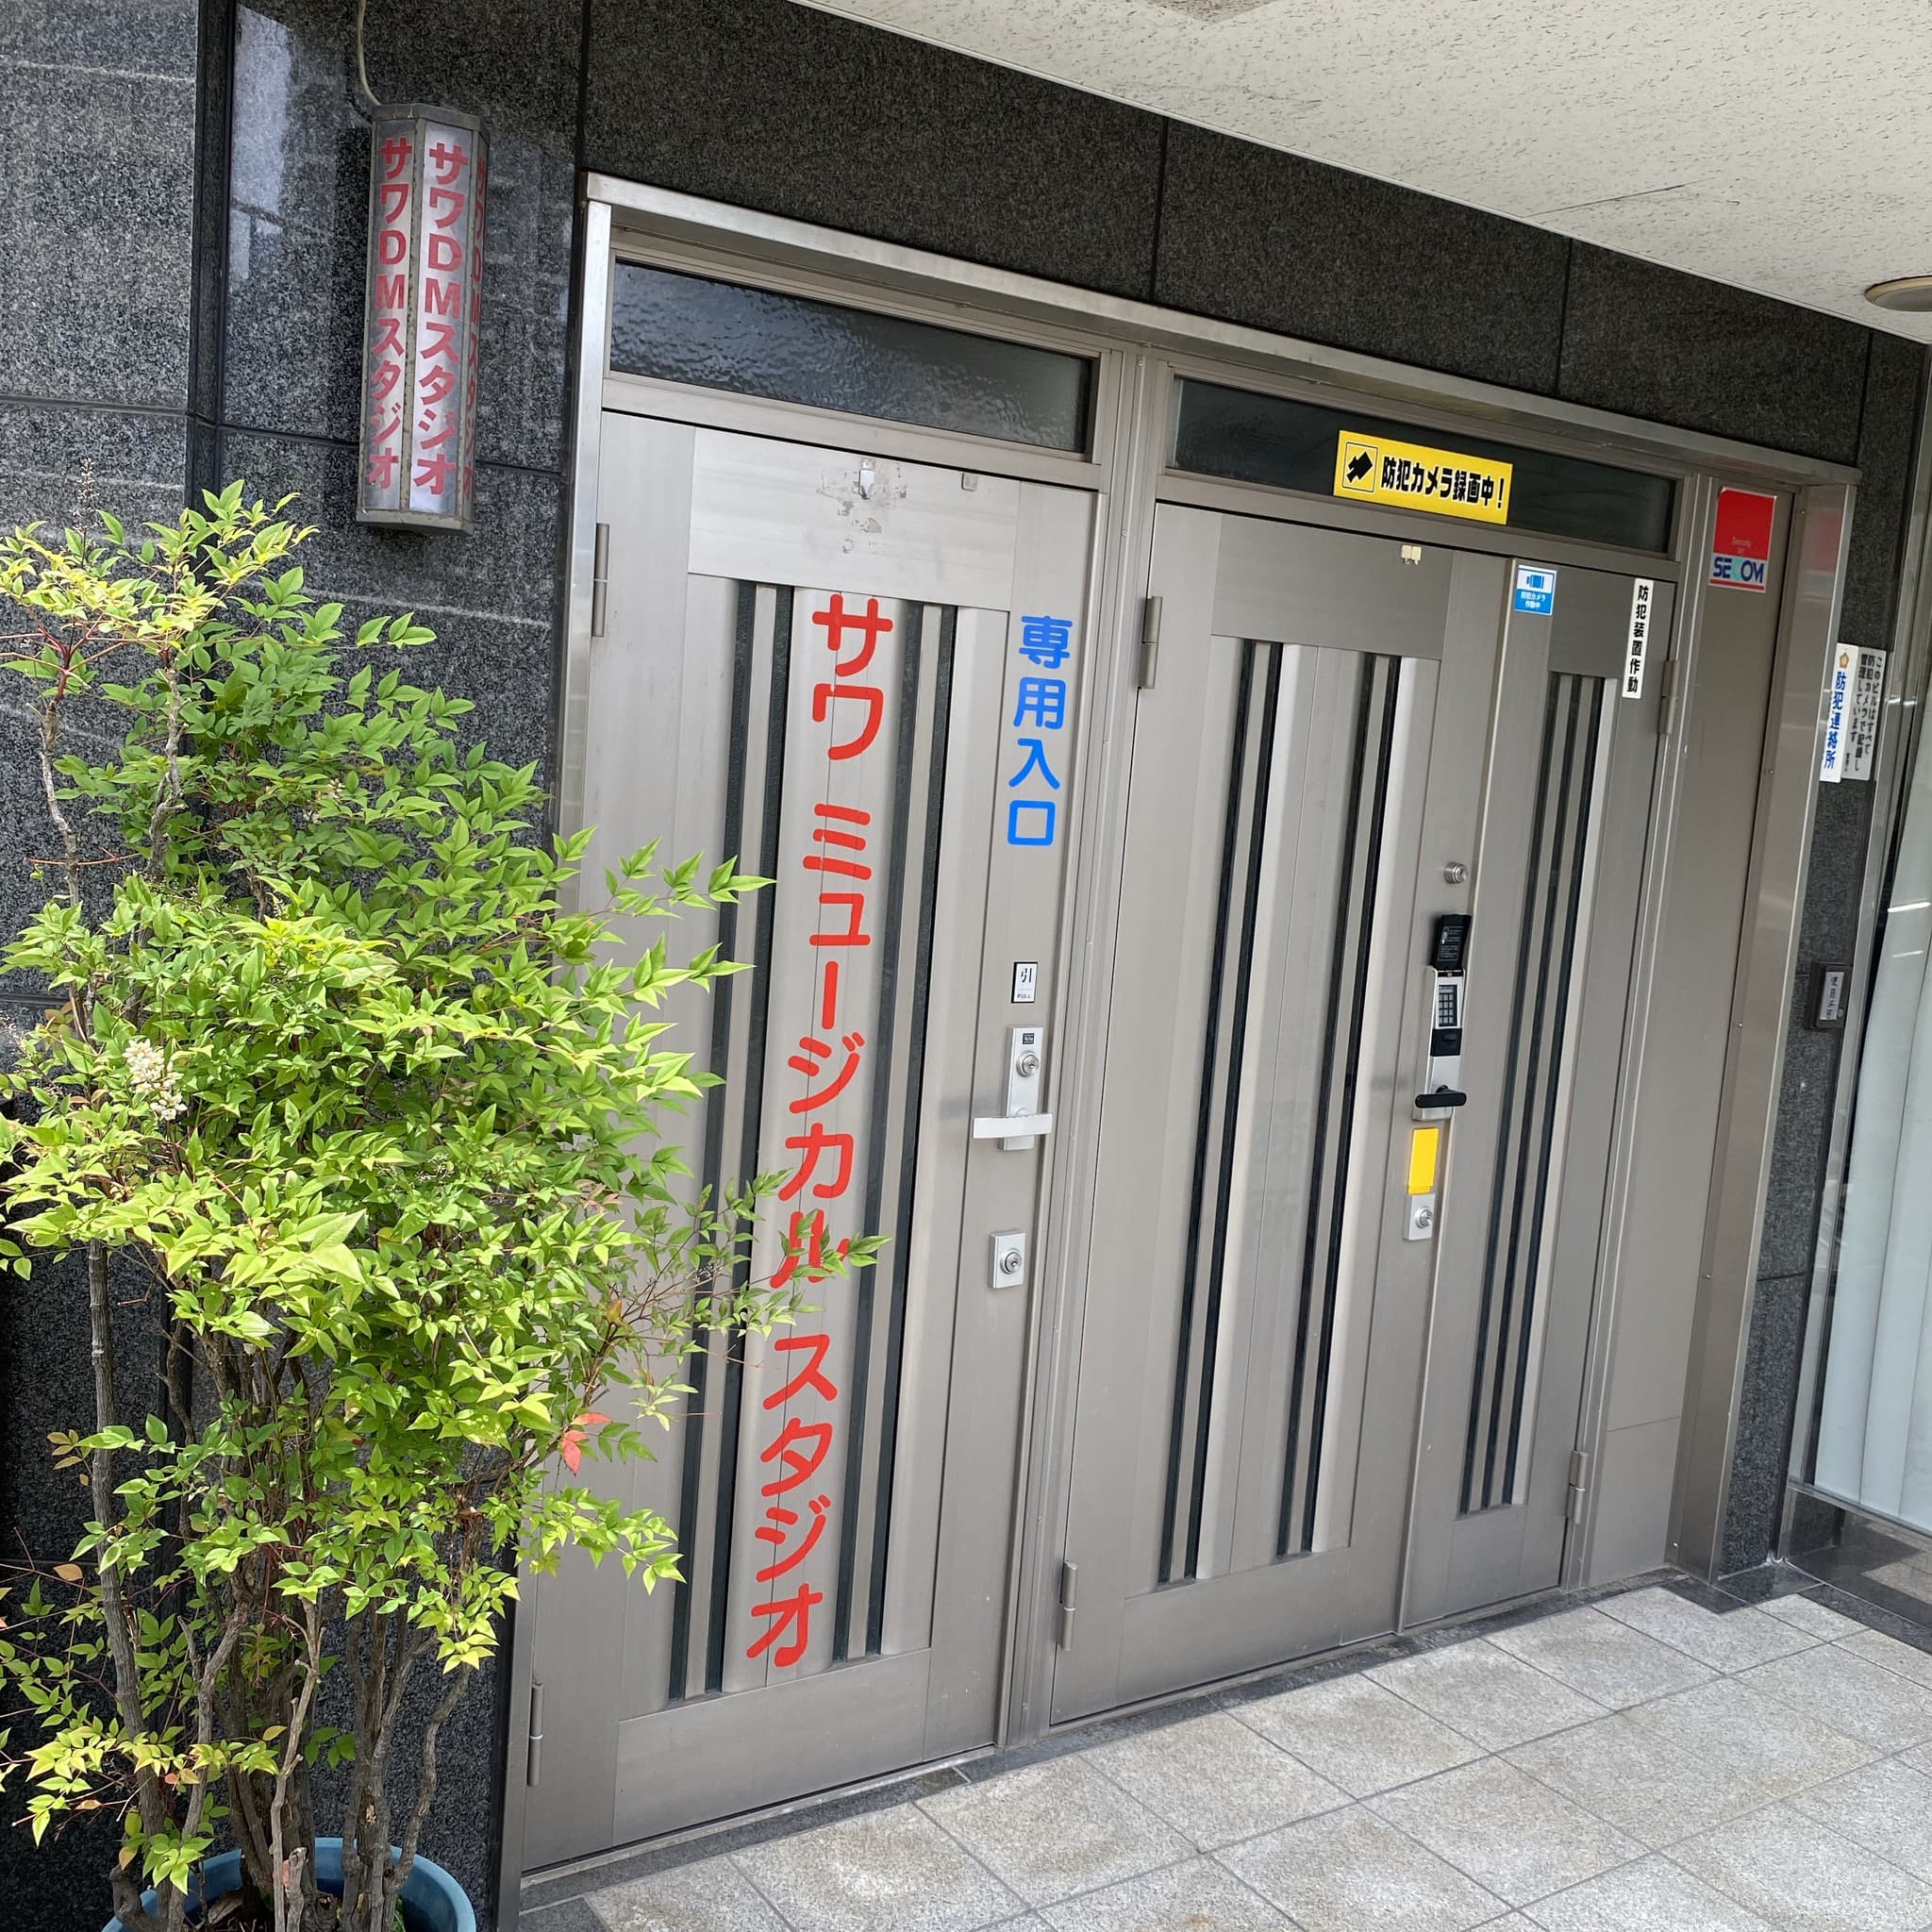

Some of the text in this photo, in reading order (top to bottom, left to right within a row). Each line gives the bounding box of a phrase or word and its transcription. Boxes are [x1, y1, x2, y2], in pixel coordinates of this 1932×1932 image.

[366, 137, 412, 490] サワDMスタジオ
[413, 142, 469, 496] サワDMスタジオ
[1626, 585, 1650, 693] 防犯装置作動
[1712, 556, 1765, 584] SECOM
[811, 593, 894, 761] サワ
[1007, 615, 1074, 847] 専用入口
[1824, 671, 1847, 770] 防犯連絡所
[1864, 655, 1883, 756] このビルはすべて
[1020, 967, 1034, 983] 引
[746, 1333, 839, 1669] スタジオ
